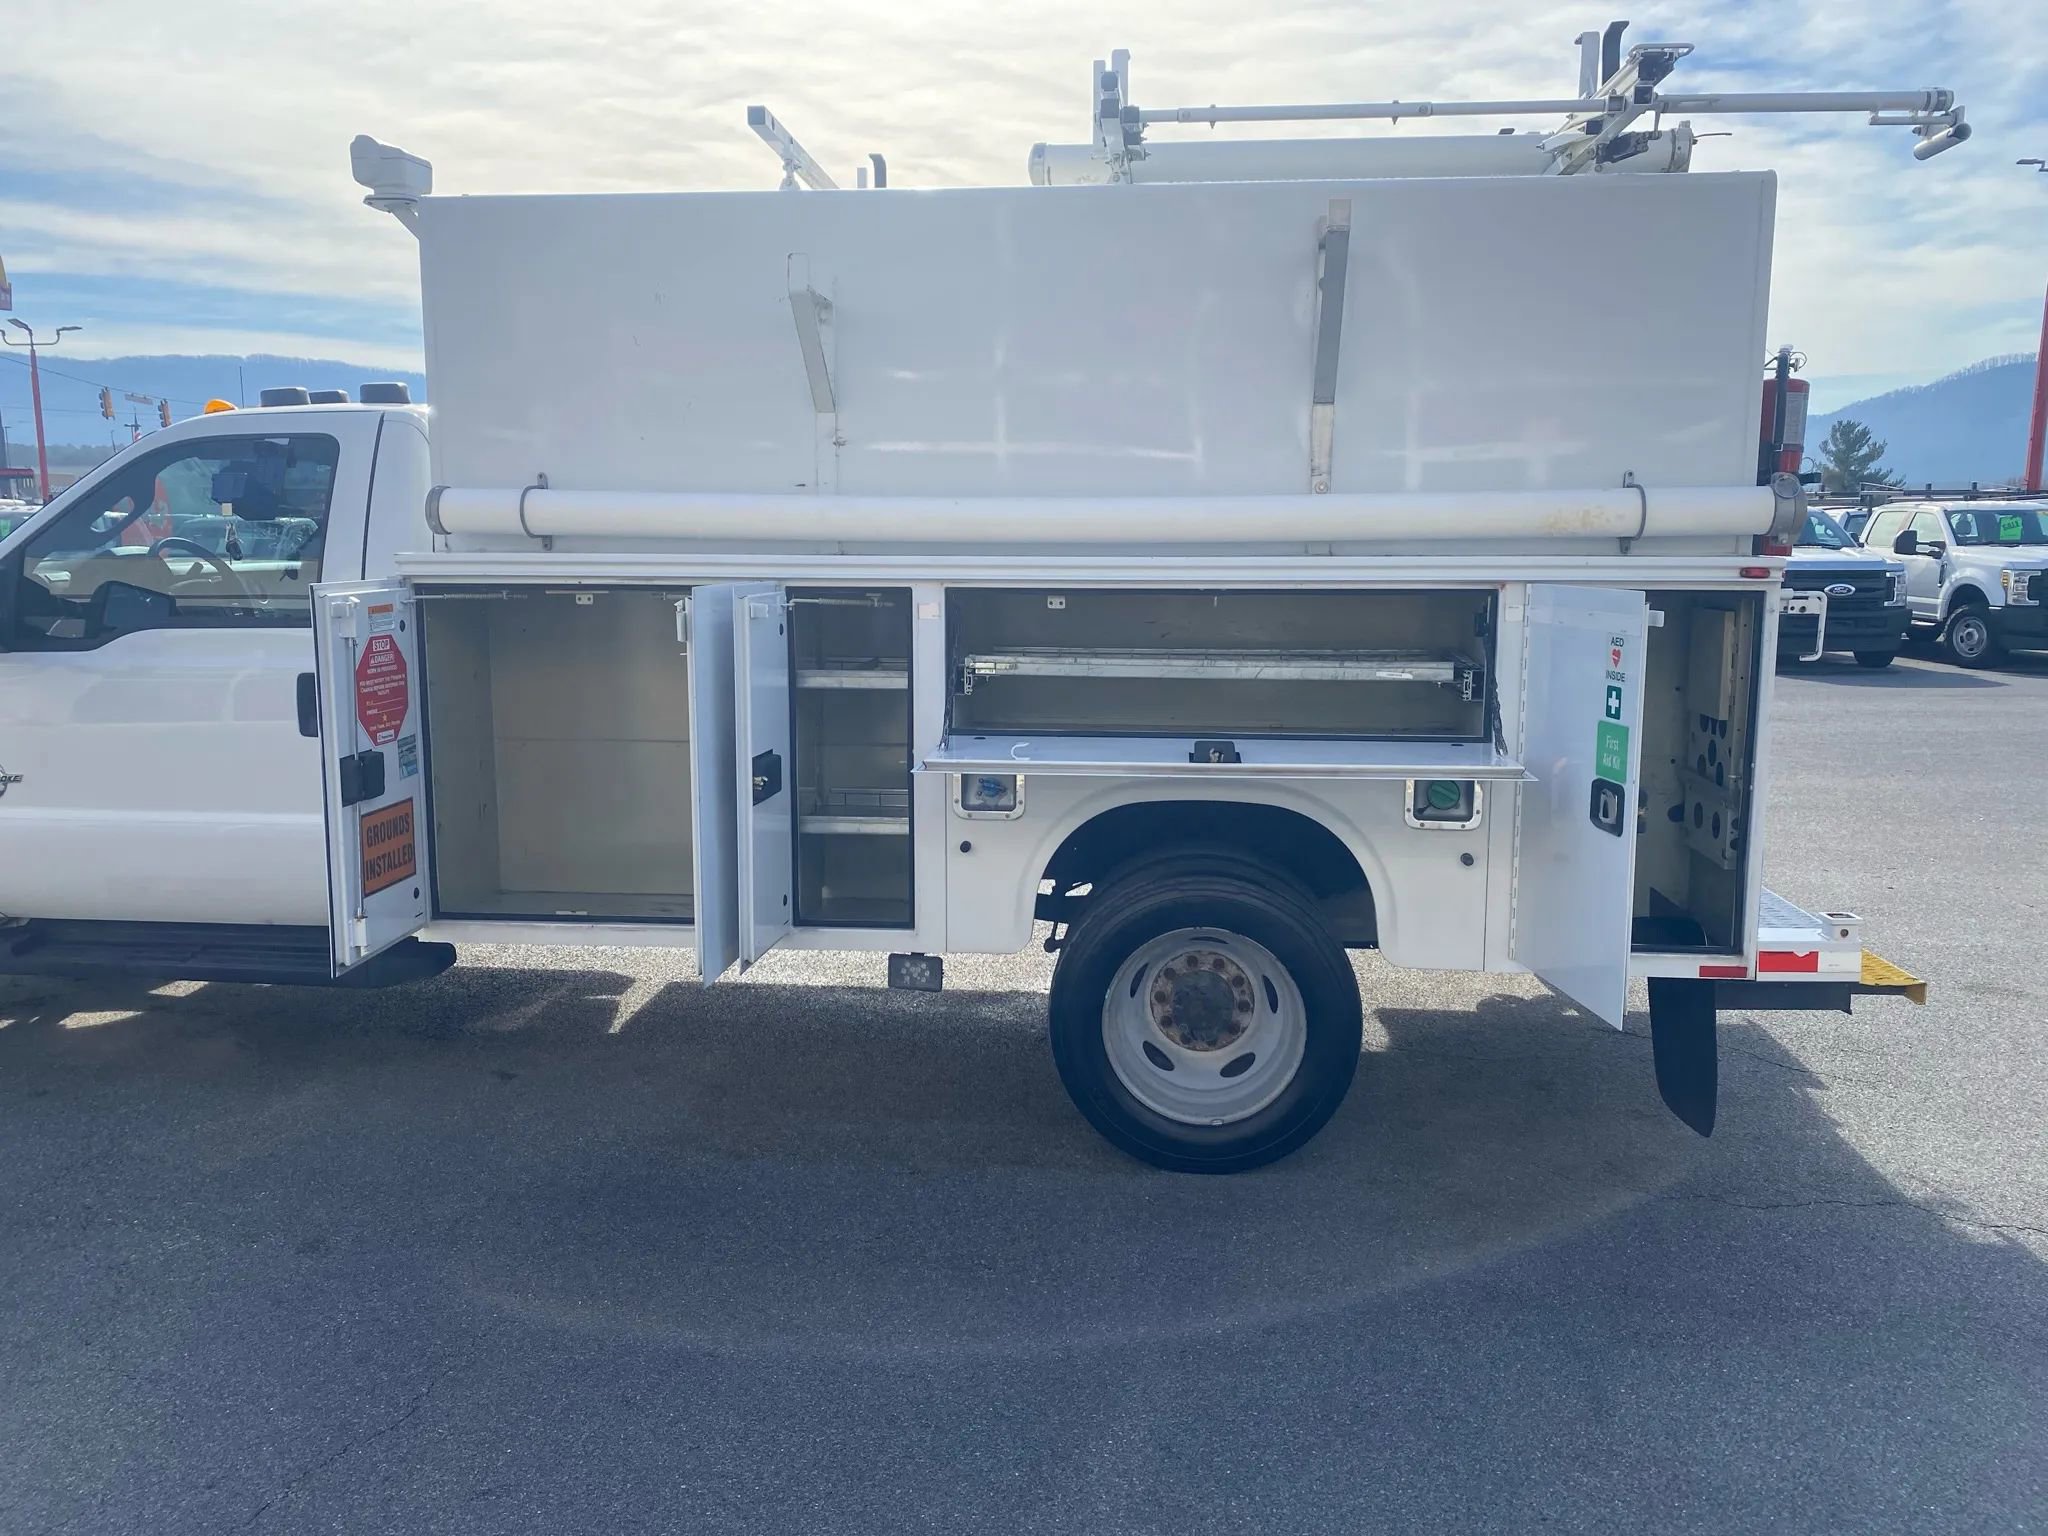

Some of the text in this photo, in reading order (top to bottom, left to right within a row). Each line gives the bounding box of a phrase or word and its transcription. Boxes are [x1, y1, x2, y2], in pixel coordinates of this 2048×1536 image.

[373, 639, 389, 650] STOP
[1610, 636, 1625, 648] AED
[374, 654, 393, 662] DANGER
[1605, 669, 1626, 683] INSIDE
[1606, 735, 1619, 752] First
[1602, 752, 1621, 770] Aid Kit
[367, 813, 409, 847] GROUNDS
[366, 843, 412, 881] INSTALLED
